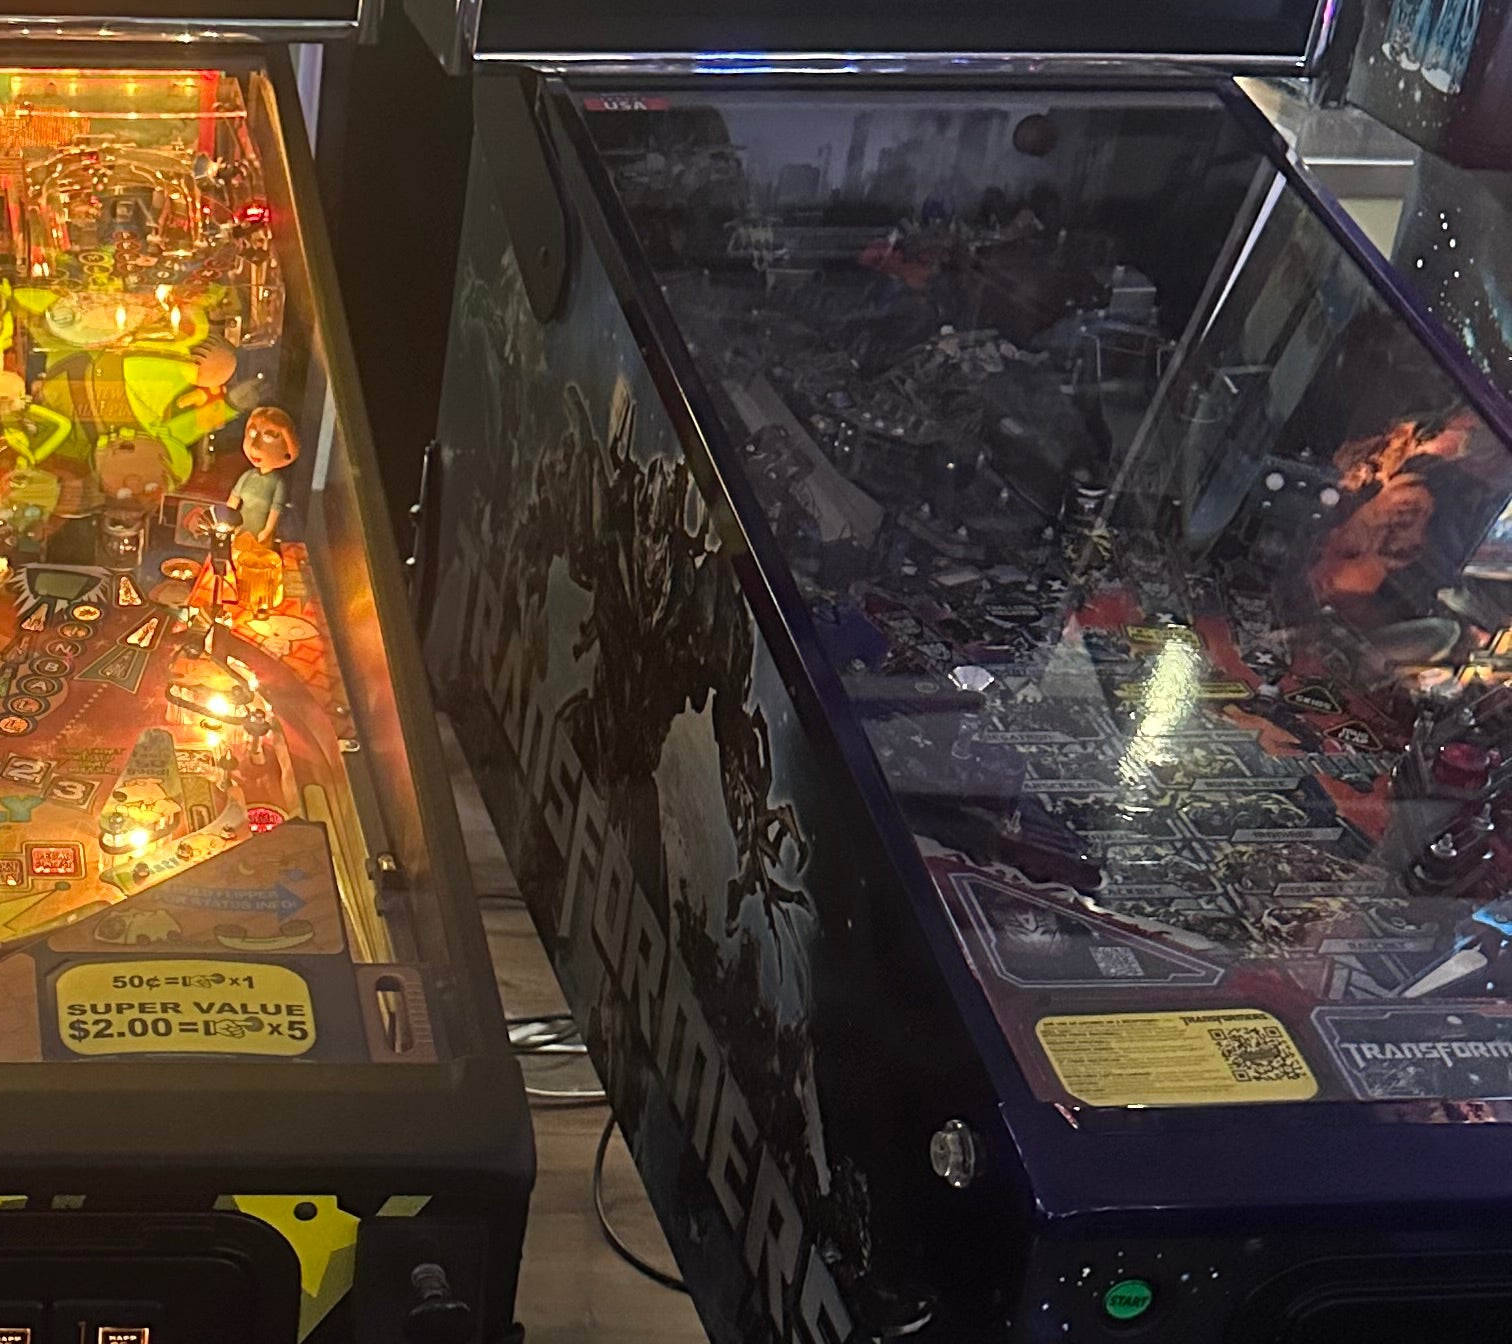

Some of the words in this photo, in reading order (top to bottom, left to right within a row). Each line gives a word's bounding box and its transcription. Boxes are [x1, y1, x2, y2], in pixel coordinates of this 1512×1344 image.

[12, 761, 40, 781] 2
[53, 781, 87, 800] 3
[66, 1002, 182, 1016] SUPER
[193, 1002, 306, 1017] VALUE
[1110, 1295, 1148, 1308] START
